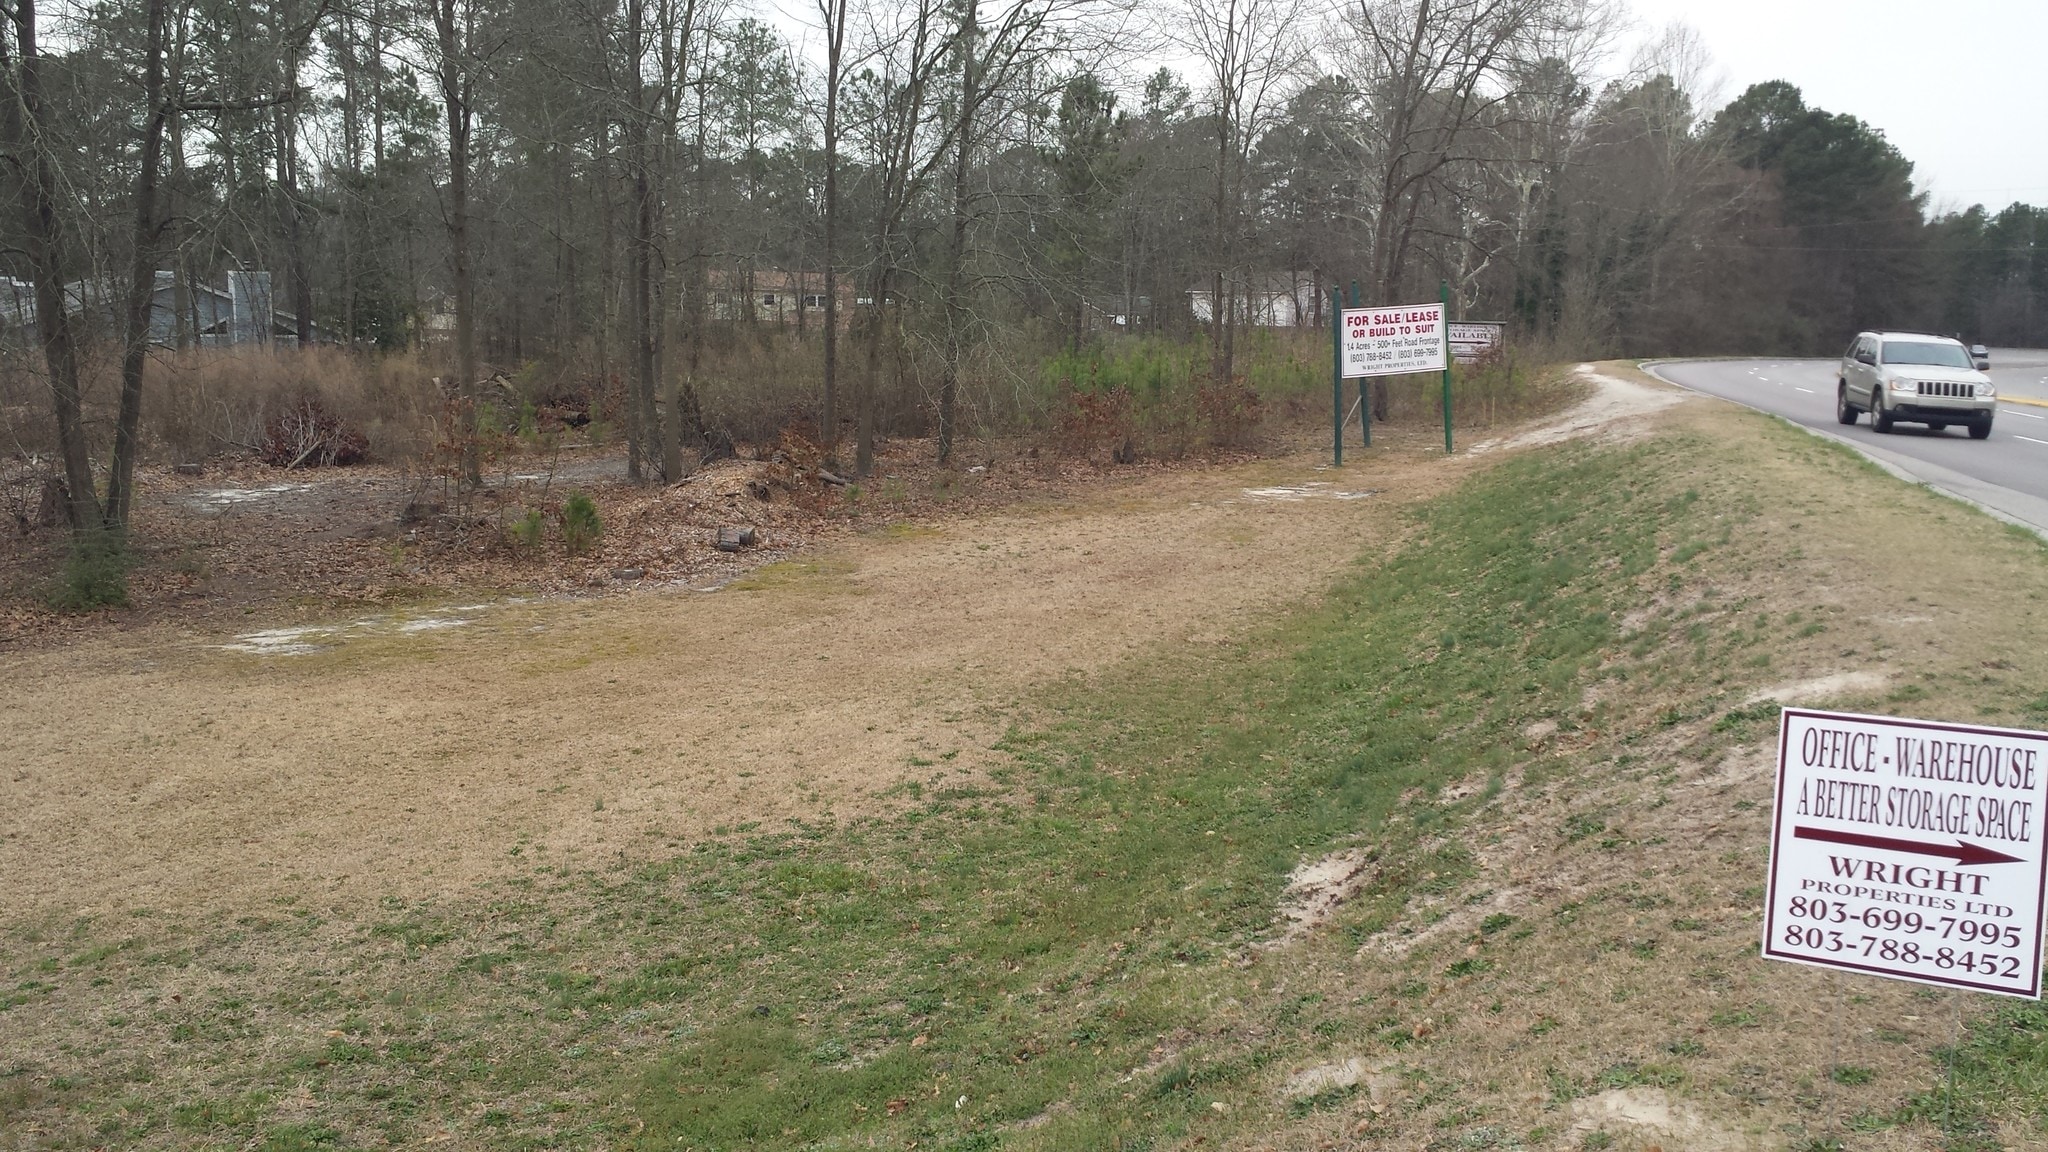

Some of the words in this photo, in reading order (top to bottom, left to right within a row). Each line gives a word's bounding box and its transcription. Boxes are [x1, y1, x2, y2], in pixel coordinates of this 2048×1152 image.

[1347, 316, 1369, 327] FOR
[1374, 311, 1439, 325] SALE/LEASE
[1352, 329, 1366, 339] OR
[1369, 327, 1396, 338] BUILD
[1399, 326, 1411, 335] TO
[1415, 324, 1435, 334] SUIT
[1355, 342, 1371, 350] Acres
[1392, 339, 1403, 348] Feet
[1404, 338, 1418, 347] Road
[1419, 337, 1440, 346] Frontage
[1802, 727, 1878, 773] OFFICE
[1896, 736, 2037, 790] WAREHOUSE
[1797, 777, 1809, 815] A
[1813, 778, 1881, 825] BETTER
[1885, 786, 1971, 835] STORAGE
[1975, 796, 2032, 842] SPACE
[1829, 855, 1990, 896] WRIGHT
[1800, 879, 1956, 911] PROPERTIES
[1964, 901, 2014, 918] LTD
[1789, 896, 2022, 949] 803-699-7995
[1784, 925, 2021, 979] 803-788-8452
